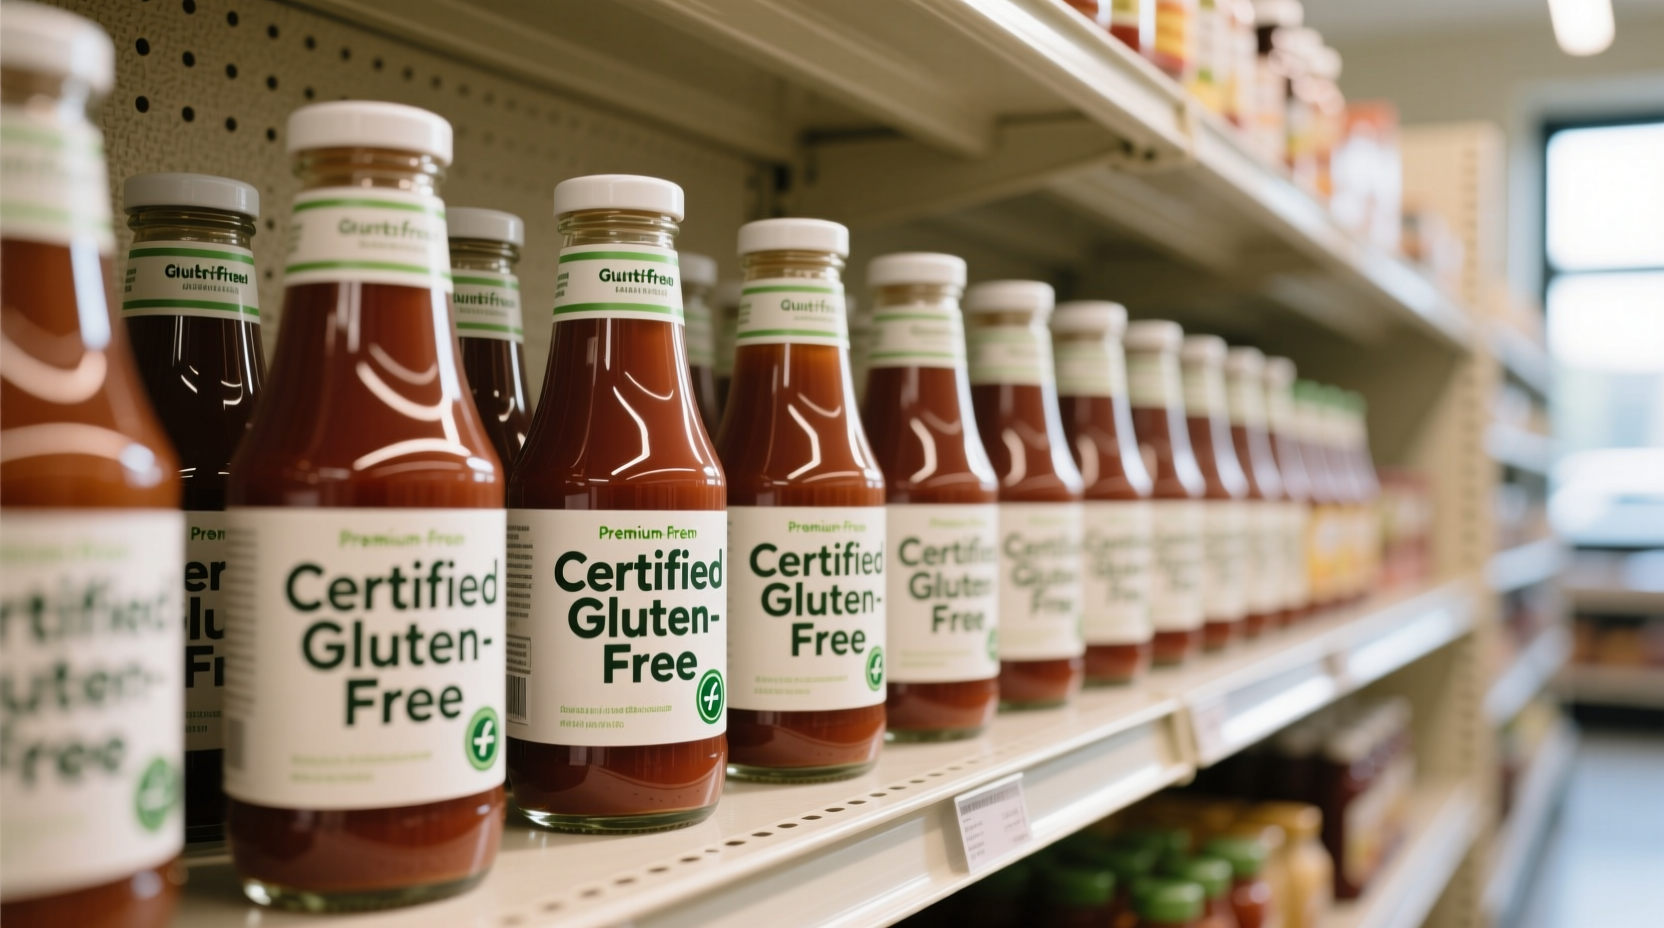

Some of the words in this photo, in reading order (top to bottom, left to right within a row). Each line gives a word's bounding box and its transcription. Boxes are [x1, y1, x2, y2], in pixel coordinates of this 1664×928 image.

[554, 548, 723, 592] Certified
[749, 541, 884, 578] Certified
[285, 559, 498, 613] Certified
[761, 581, 882, 617] Gluten-
[568, 596, 720, 639] Gluten-
[302, 620, 493, 670] Gluten-
[791, 622, 866, 657] Free
[603, 643, 698, 684] Free
[345, 678, 464, 726] Free
